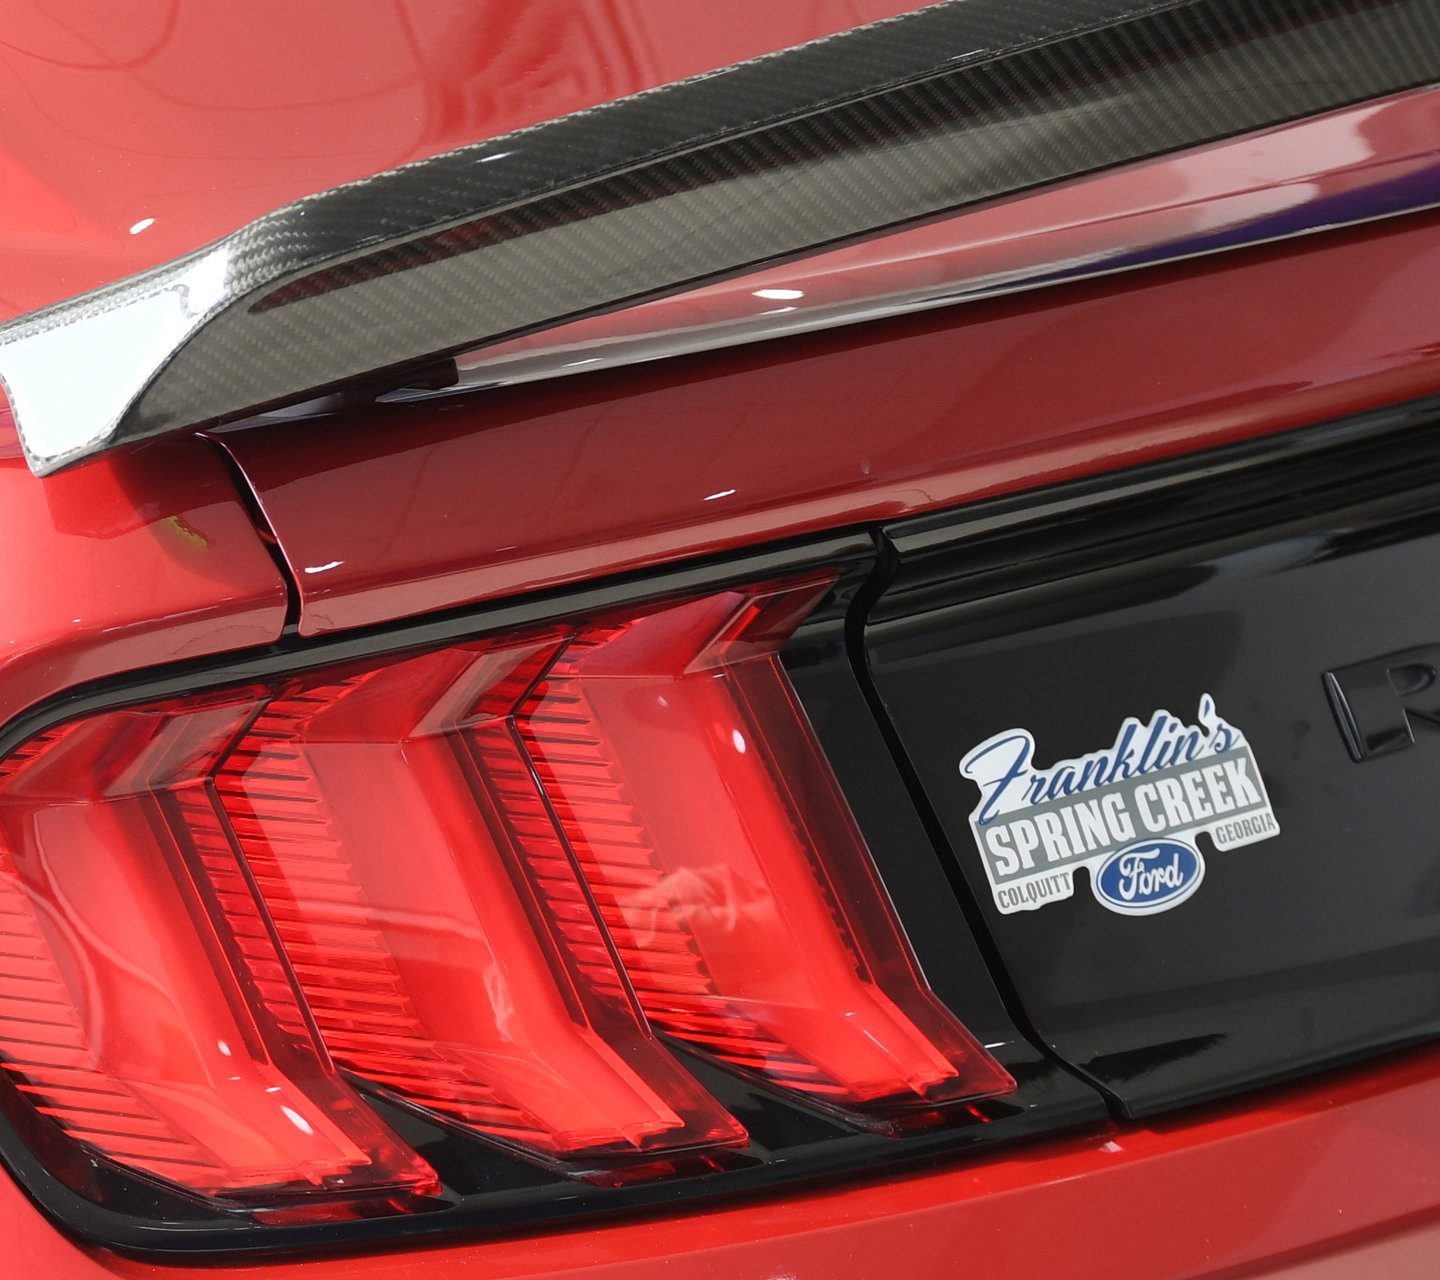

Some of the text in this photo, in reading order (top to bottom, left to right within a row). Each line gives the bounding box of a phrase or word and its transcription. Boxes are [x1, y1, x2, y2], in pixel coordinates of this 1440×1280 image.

[964, 699, 1239, 825] Franklin's
[985, 755, 1263, 876] SPRING CREEK
[1216, 812, 1276, 845] GEORGIA
[998, 871, 1073, 910] COLQUITT
[1118, 847, 1184, 902] Ford
